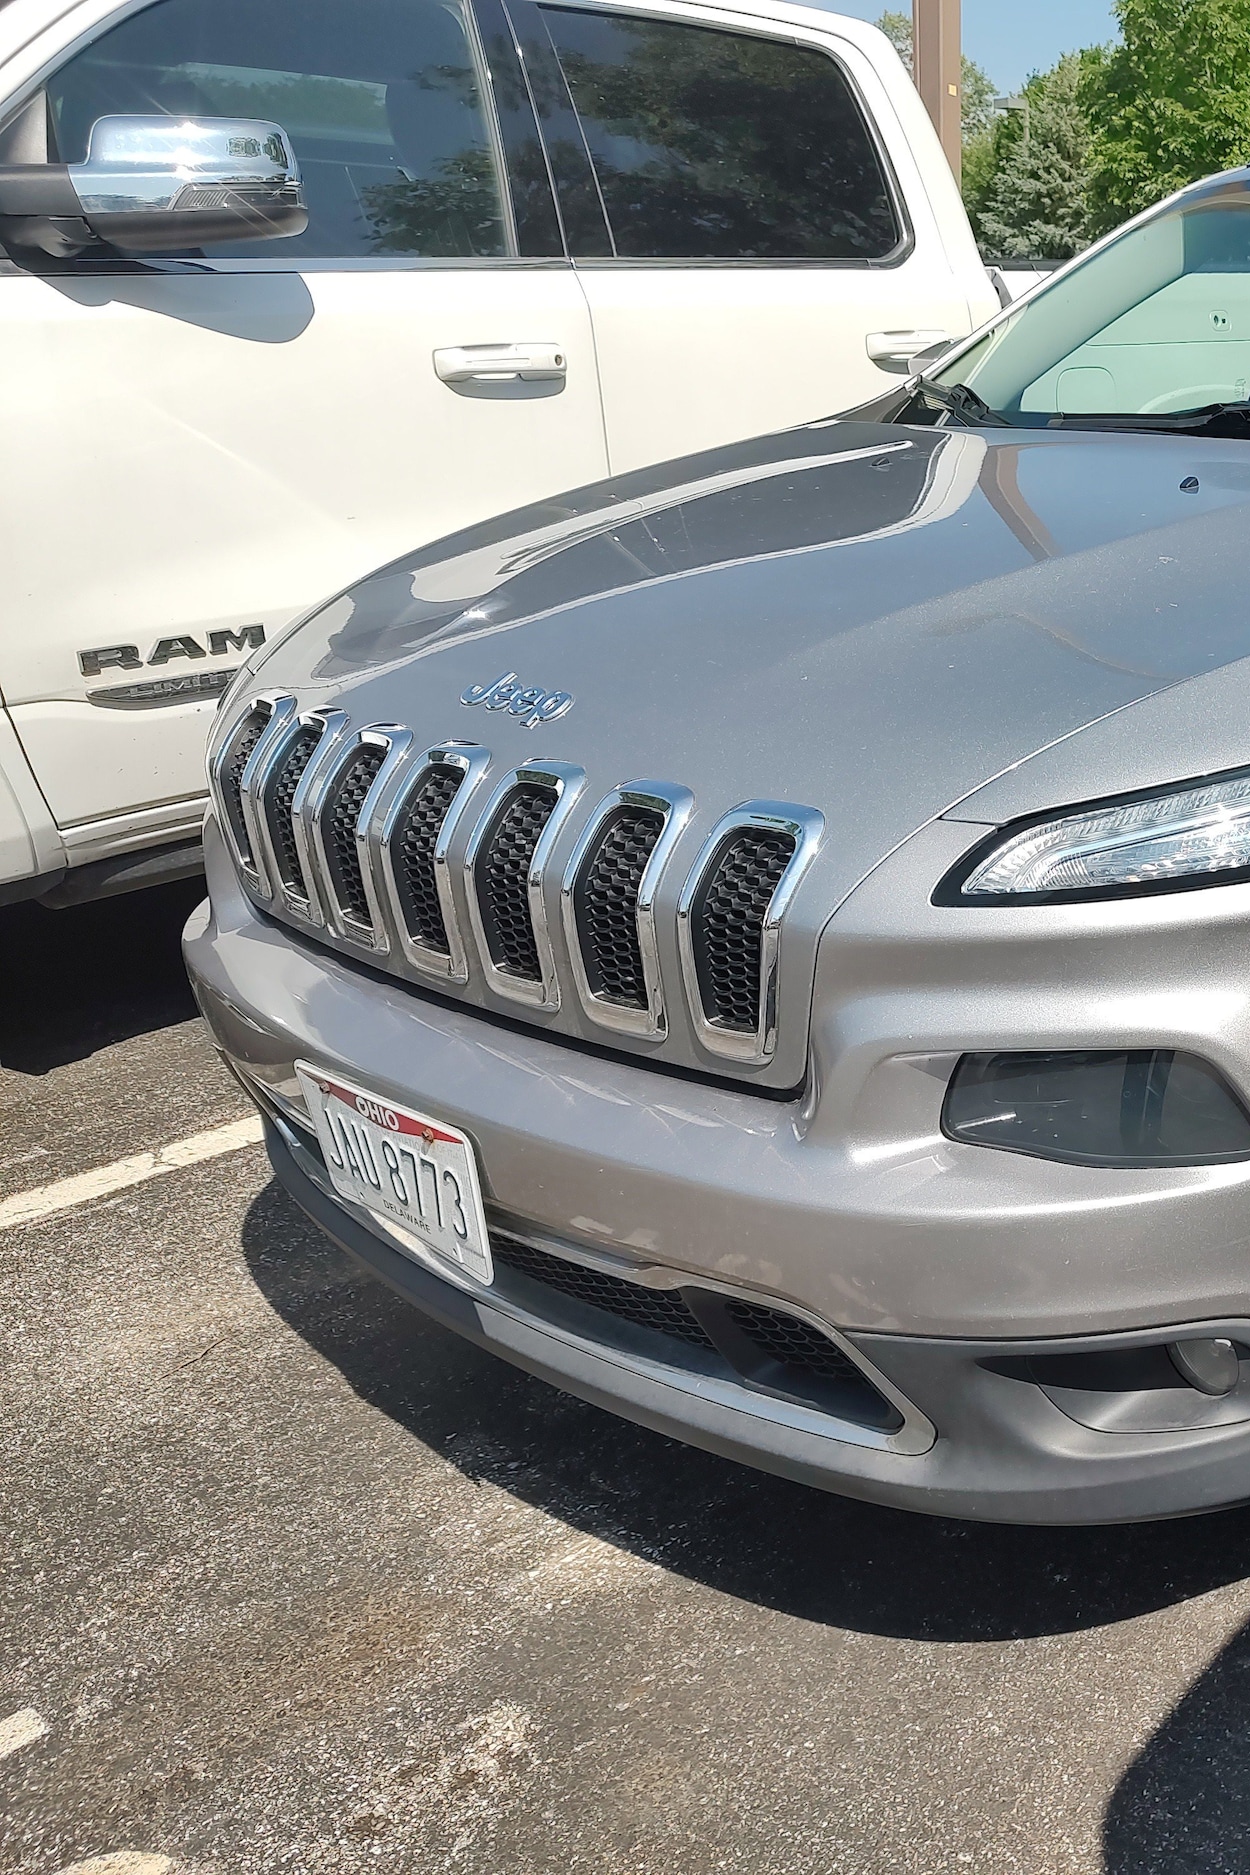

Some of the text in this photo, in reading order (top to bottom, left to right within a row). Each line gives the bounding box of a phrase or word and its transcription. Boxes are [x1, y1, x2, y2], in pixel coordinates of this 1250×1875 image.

[76, 623, 266, 677] RAM
[460, 671, 575, 730] Jeep
[355, 1096, 400, 1131] OHIO
[324, 1108, 468, 1240] JAU 8773
[382, 1198, 432, 1235] DELAWARE
